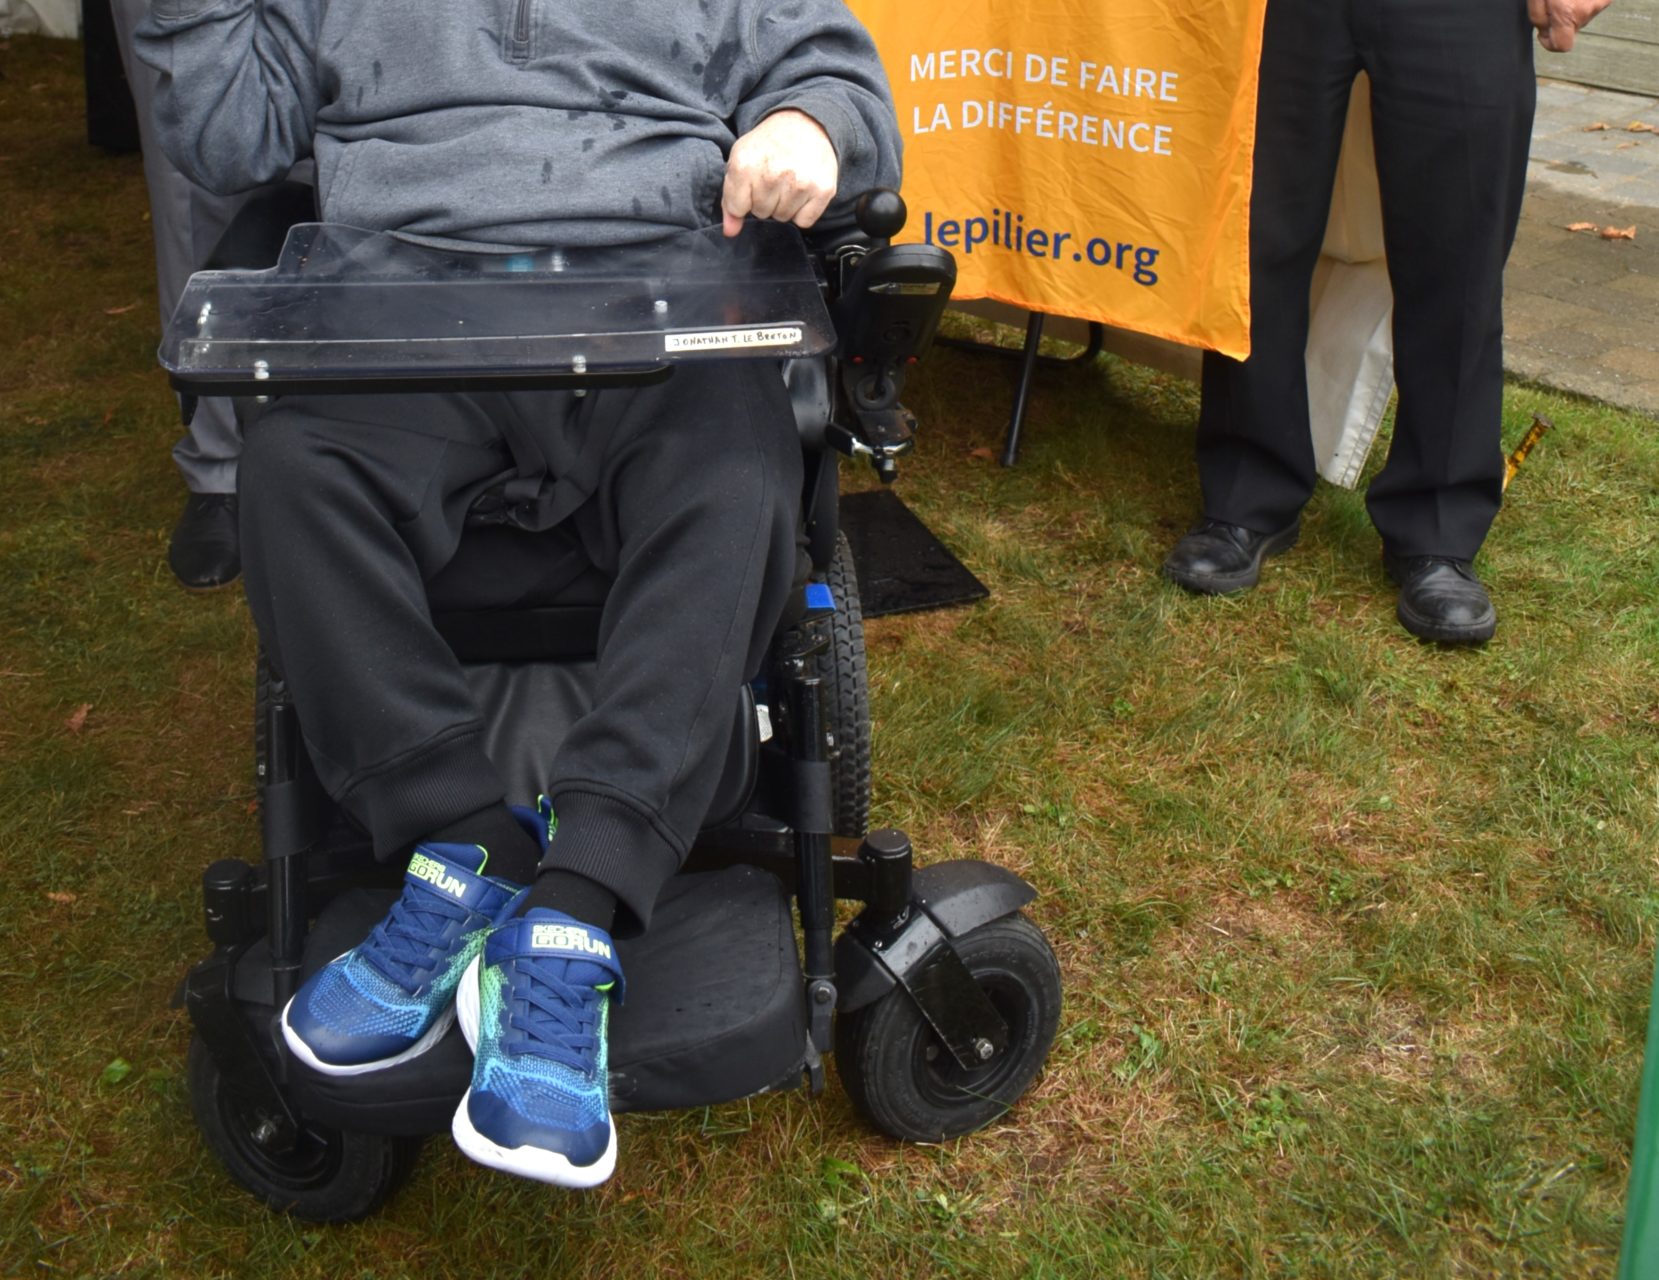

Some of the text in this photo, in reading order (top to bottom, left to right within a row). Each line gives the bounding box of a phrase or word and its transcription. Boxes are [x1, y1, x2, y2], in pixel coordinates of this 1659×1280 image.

[910, 48, 1179, 103] MERCI DE FAIRE
[913, 100, 1173, 156] LA DIFFÉRENCE
[924, 209, 1160, 286] lepilier.org
[673, 336, 729, 347] JONATHAN
[743, 334, 753, 343] LE
